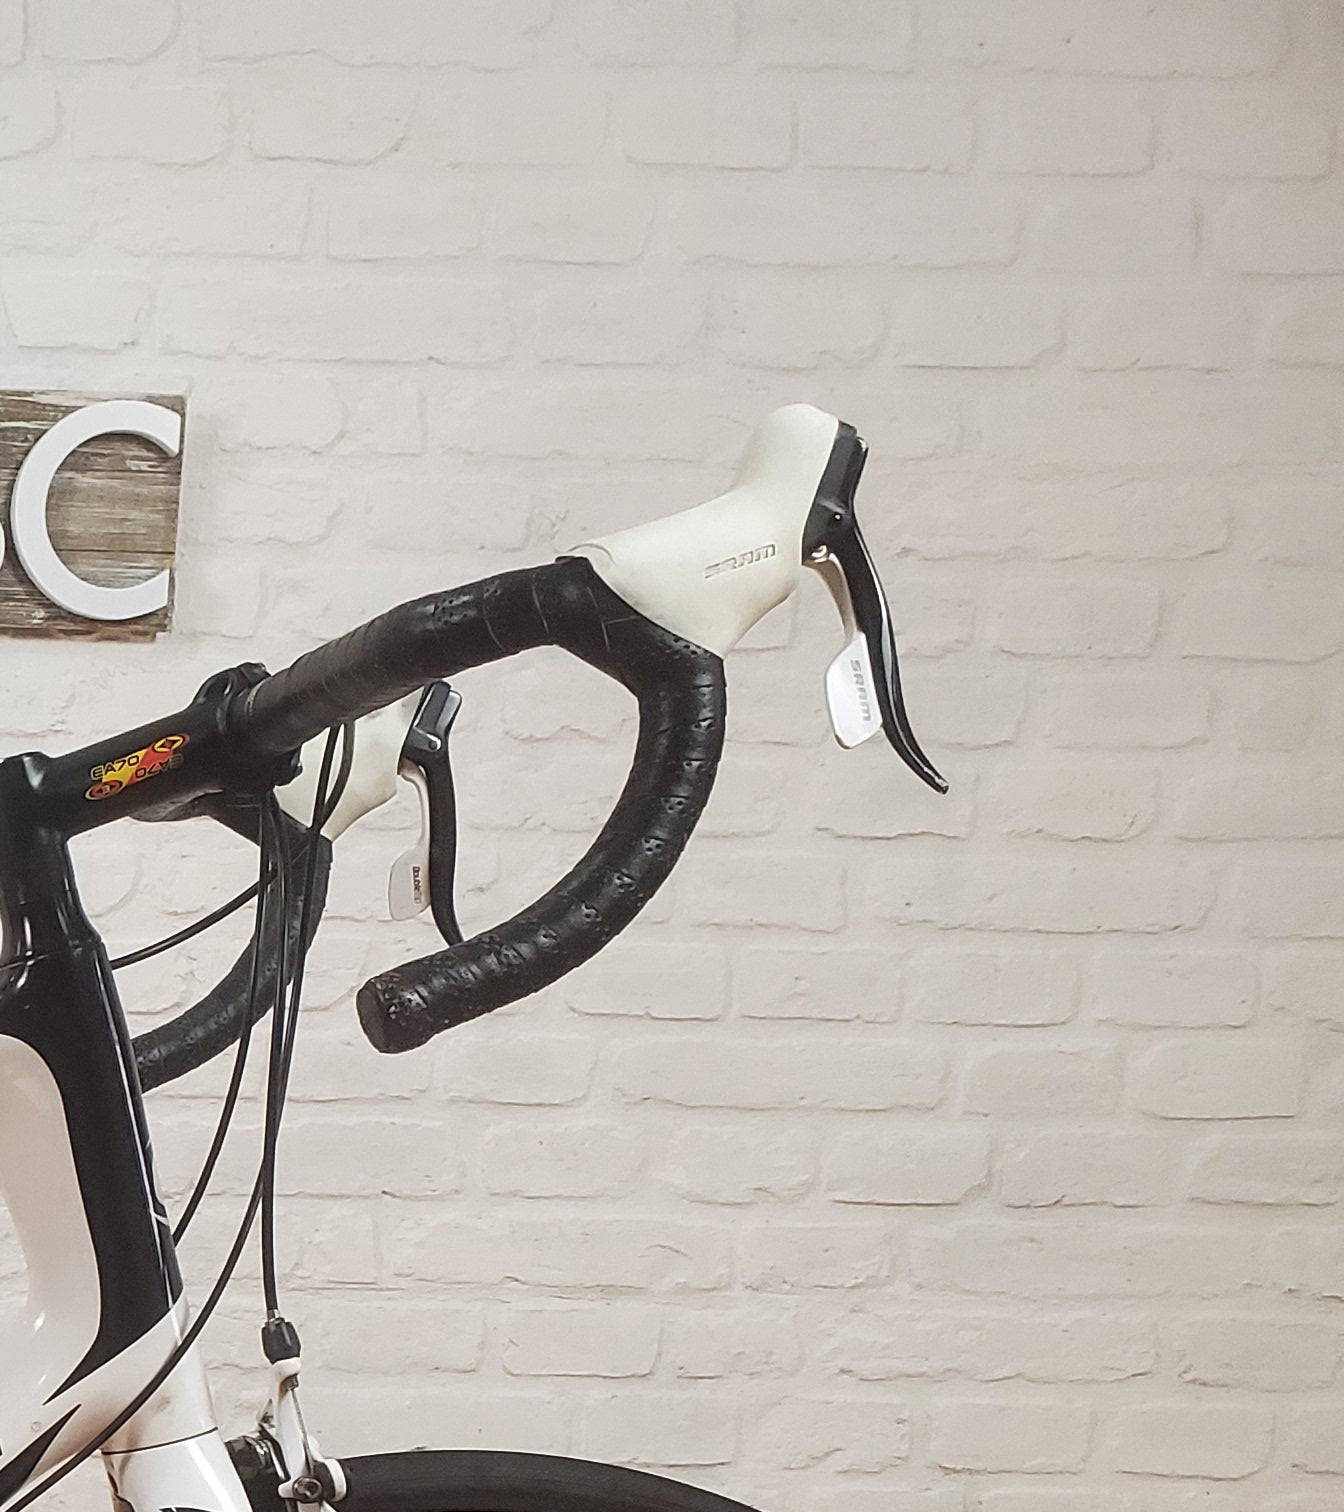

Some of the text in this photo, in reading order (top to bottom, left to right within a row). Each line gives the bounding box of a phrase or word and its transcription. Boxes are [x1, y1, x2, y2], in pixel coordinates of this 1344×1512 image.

[704, 543, 776, 579] SRAM
[850, 659, 872, 722] SRAM
[90, 753, 141, 782] EA70
